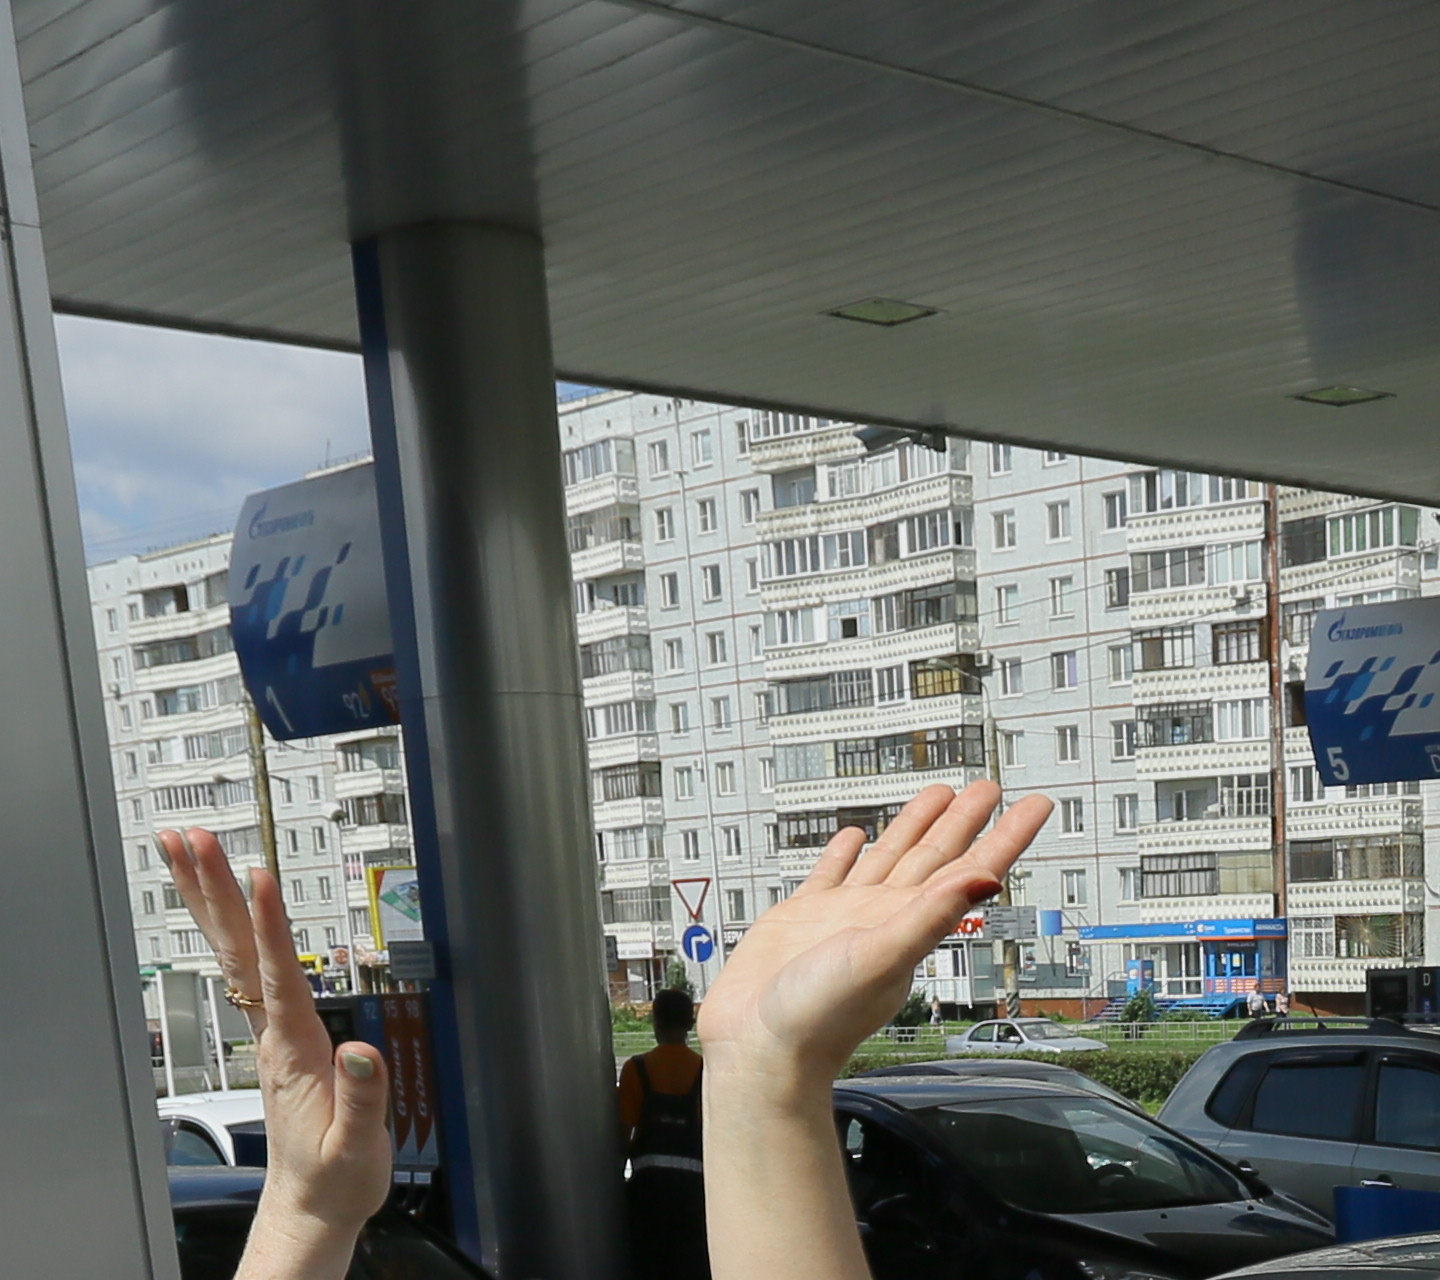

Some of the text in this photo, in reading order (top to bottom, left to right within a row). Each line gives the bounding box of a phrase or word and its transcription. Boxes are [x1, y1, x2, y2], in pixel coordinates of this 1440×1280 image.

[265, 686, 294, 733] 1
[342, 692, 371, 719] 92
[1327, 746, 1350, 781] 5
